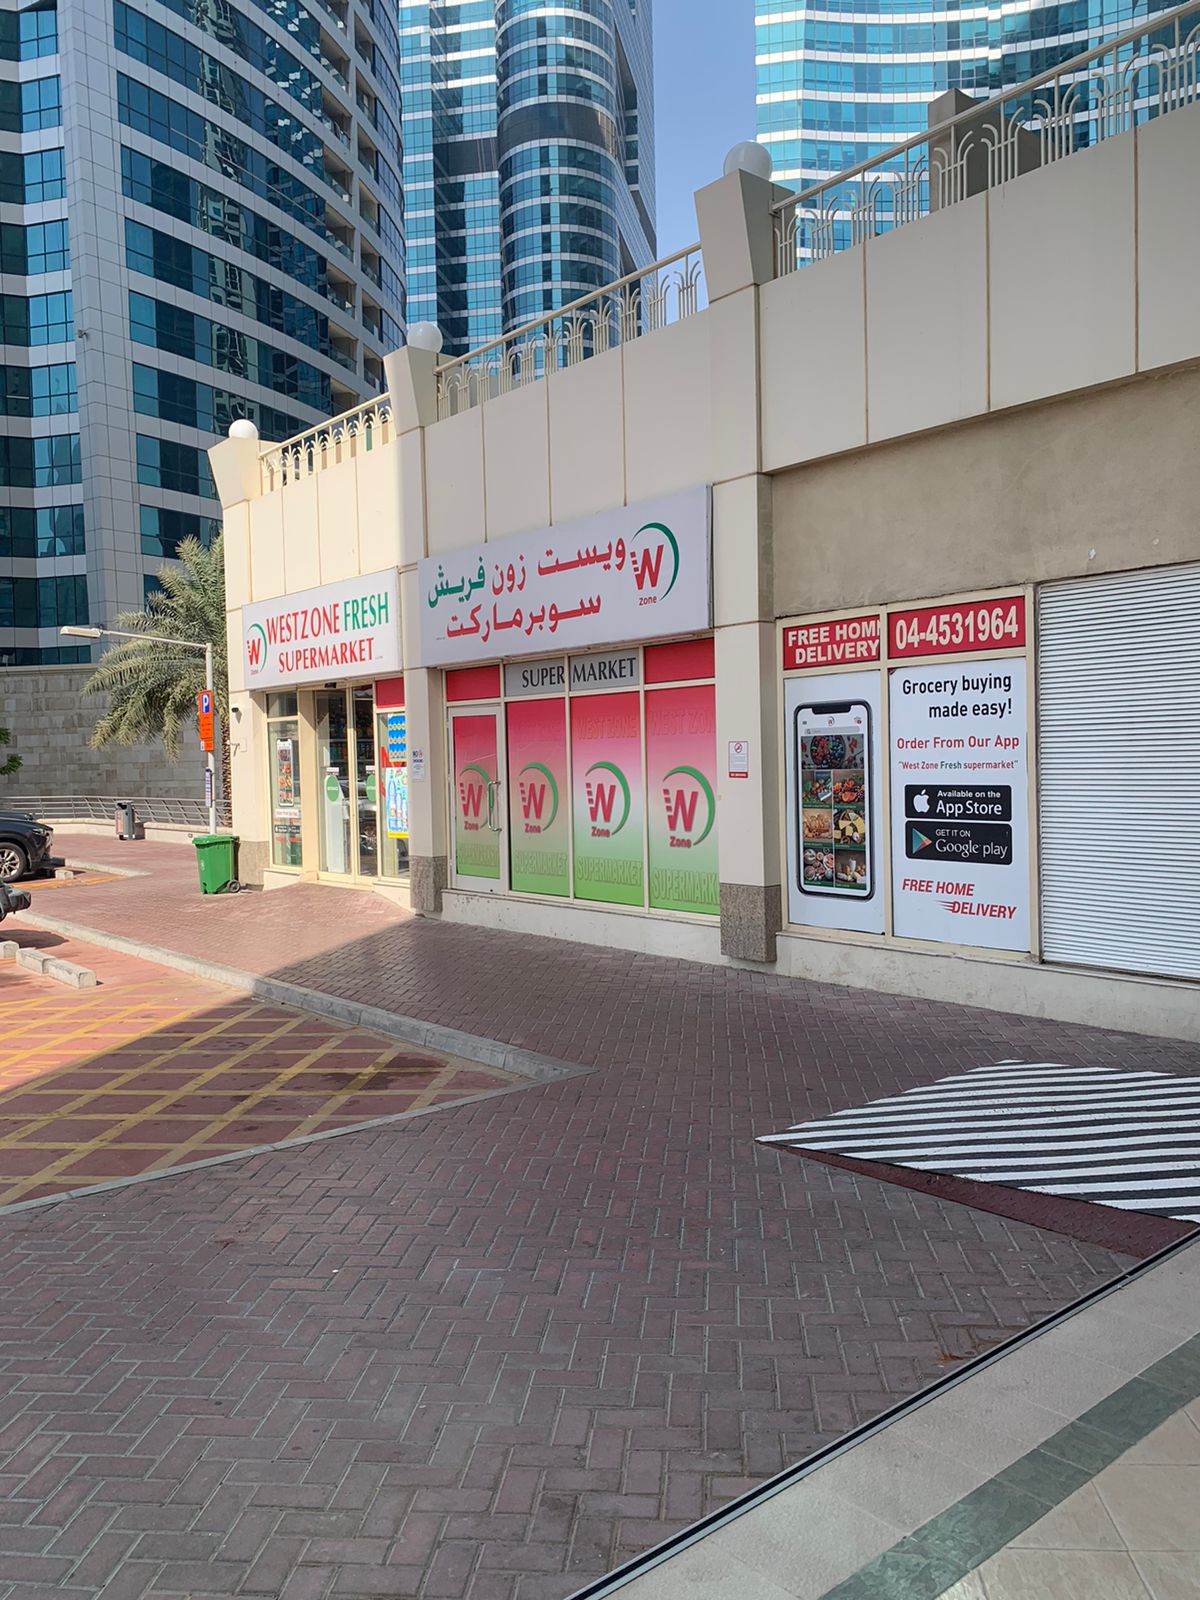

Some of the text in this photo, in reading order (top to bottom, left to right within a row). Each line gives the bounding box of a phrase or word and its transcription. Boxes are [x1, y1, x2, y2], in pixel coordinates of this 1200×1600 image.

[428, 537, 626, 608] ويست زون فريش
[639, 595, 657, 606] zone
[343, 592, 389, 631] FRESH
[447, 594, 602, 642] سوبرماركت
[788, 619, 880, 647] FREE HOM
[895, 605, 1018, 650] 04-4531964
[279, 637, 374, 673] SUPERMARKET
[795, 638, 880, 664] DELIVERY
[522, 657, 636, 688] SUPER MARKET
[902, 673, 1012, 696] Grocery buying
[202, 694, 210, 714] P
[929, 698, 1012, 719] made easy!
[897, 735, 1019, 750] Order From Our App
[921, 761, 938, 769] Zone
[940, 760, 962, 769] Fresh
[937, 790, 973, 798] Available
[936, 800, 1002, 817] App Store
[935, 829, 950, 837] GET
[952, 829, 958, 837] IT
[935, 839, 1008, 859] Google play
[902, 878, 975, 896] FREE HOME
[951, 901, 1017, 919] DELIVERY
